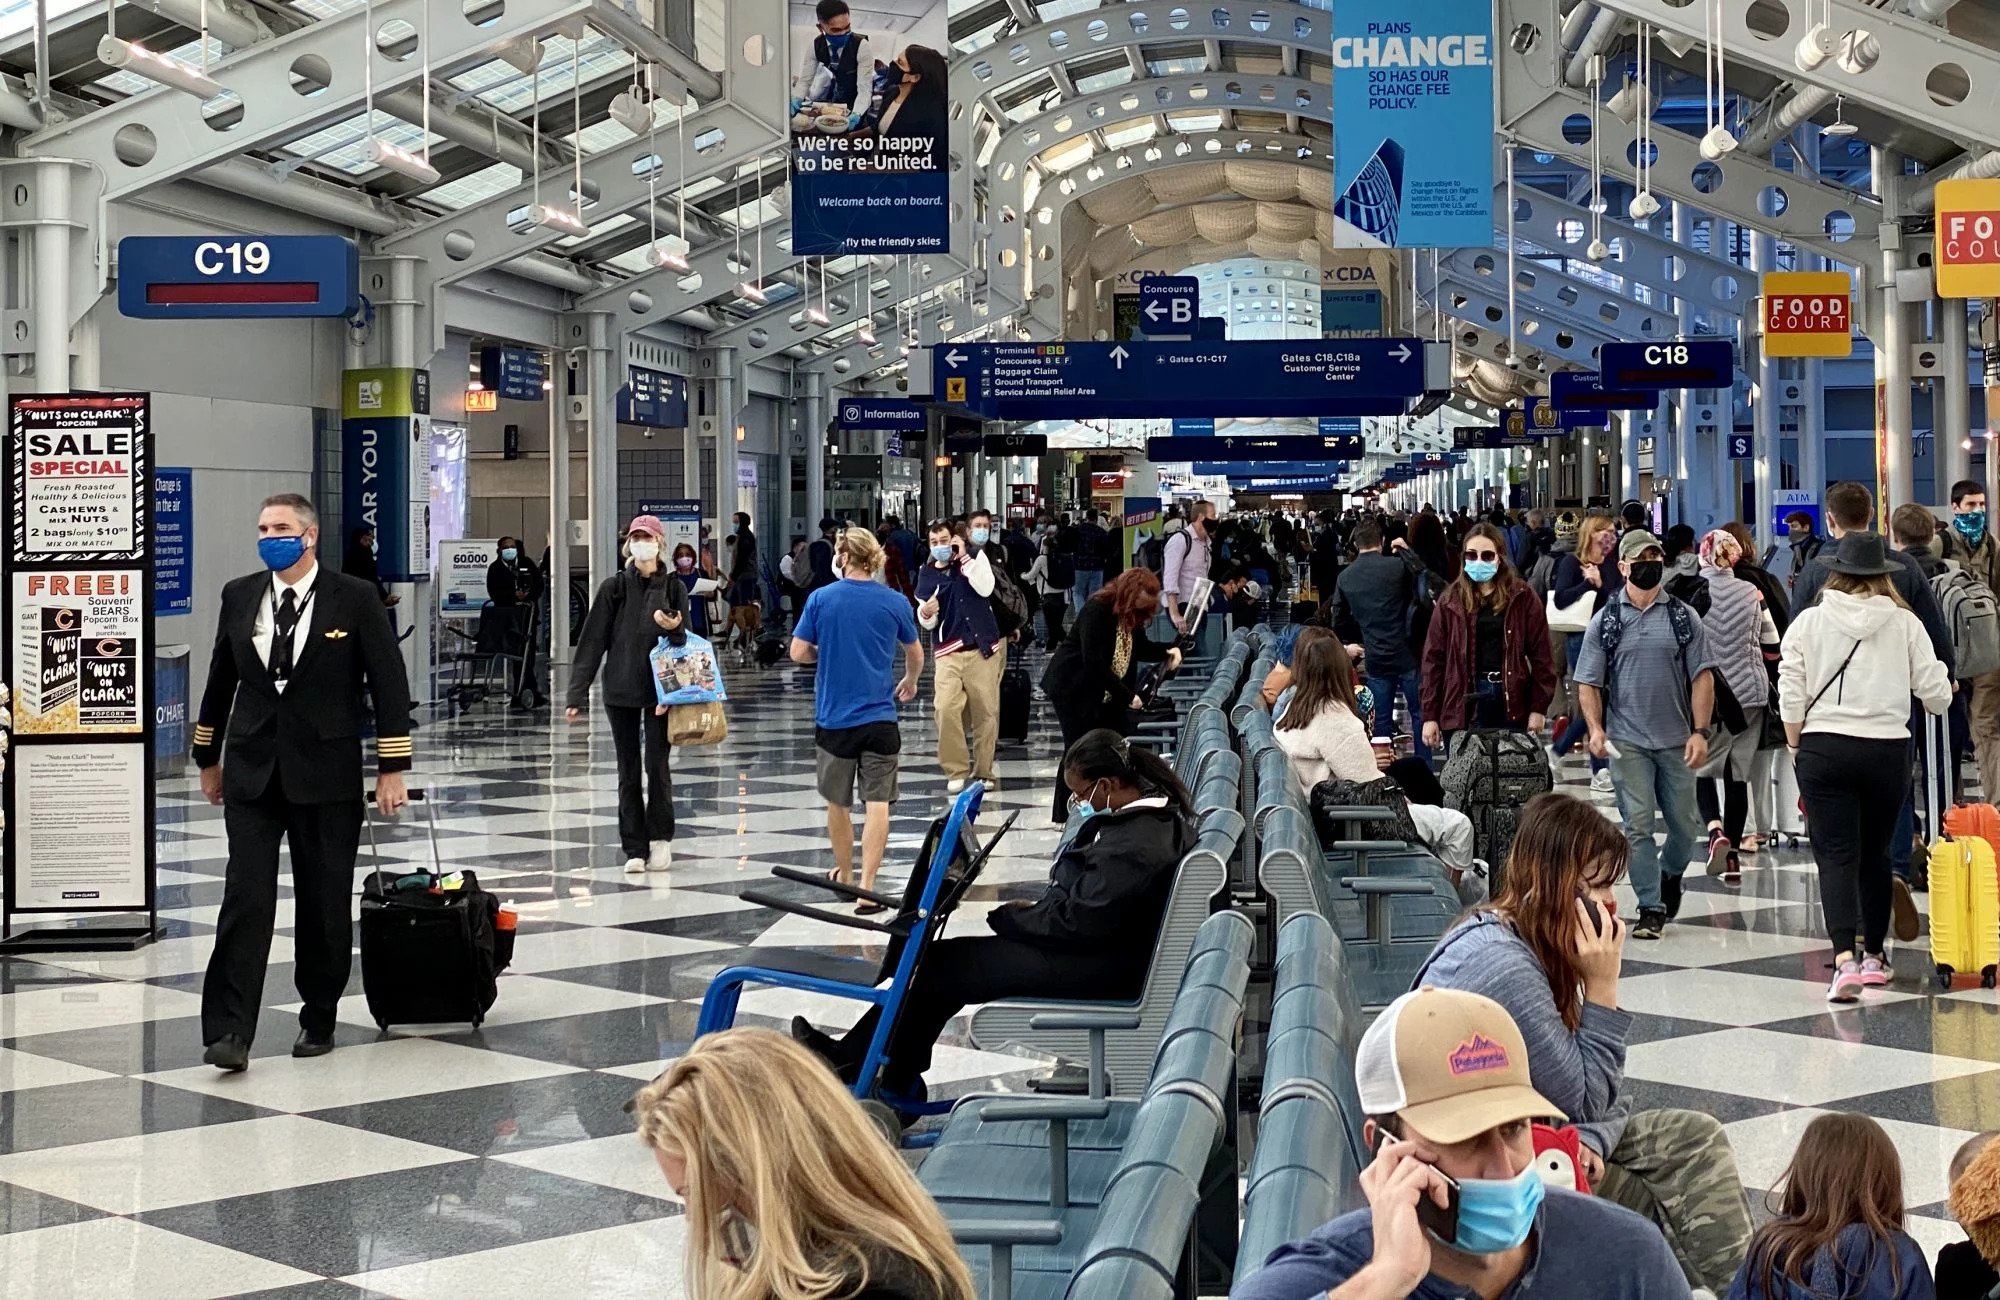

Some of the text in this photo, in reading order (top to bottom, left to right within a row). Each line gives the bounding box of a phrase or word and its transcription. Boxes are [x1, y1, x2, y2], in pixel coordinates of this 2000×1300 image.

[1368, 22, 1412, 34] PLANS
[1333, 35, 1492, 68] CHANGE.
[1368, 70, 1448, 82] SO HAS OUR
[1369, 84, 1450, 96] CHANGE FEE
[1369, 97, 1417, 109] POLICY.
[798, 134, 934, 152] We're so happy
[798, 153, 937, 171] to be re-United.
[819, 197, 864, 207] Welcome
[867, 196, 892, 206] back
[910, 196, 943, 206] board.
[846, 237, 940, 247] fly the friendly skies
[195, 242, 270, 275] C19
[1337, 267, 1375, 280] CDA
[1172, 298, 1192, 322] B
[1773, 299, 1842, 315] FOOD
[1770, 316, 1845, 329] COURT
[1282, 353, 1360, 362] Gates C18,C18a
[1645, 346, 1688, 365] C18
[468, 392, 494, 407] EXIT
[864, 410, 919, 419] Information
[29, 434, 128, 456] SALE
[1006, 436, 1025, 446] C17
[1735, 438, 1746, 455] $
[362, 429, 377, 483] YOU
[30, 461, 128, 475] SPECIAL
[155, 478, 181, 494] Change is
[155, 498, 180, 512] in the air
[44, 529, 93, 538] bags/only
[28, 575, 129, 596] FREE!
[88, 597, 133, 606] Souvenir
[93, 607, 129, 615] BEARS
[156, 702, 184, 723] O'HARE
